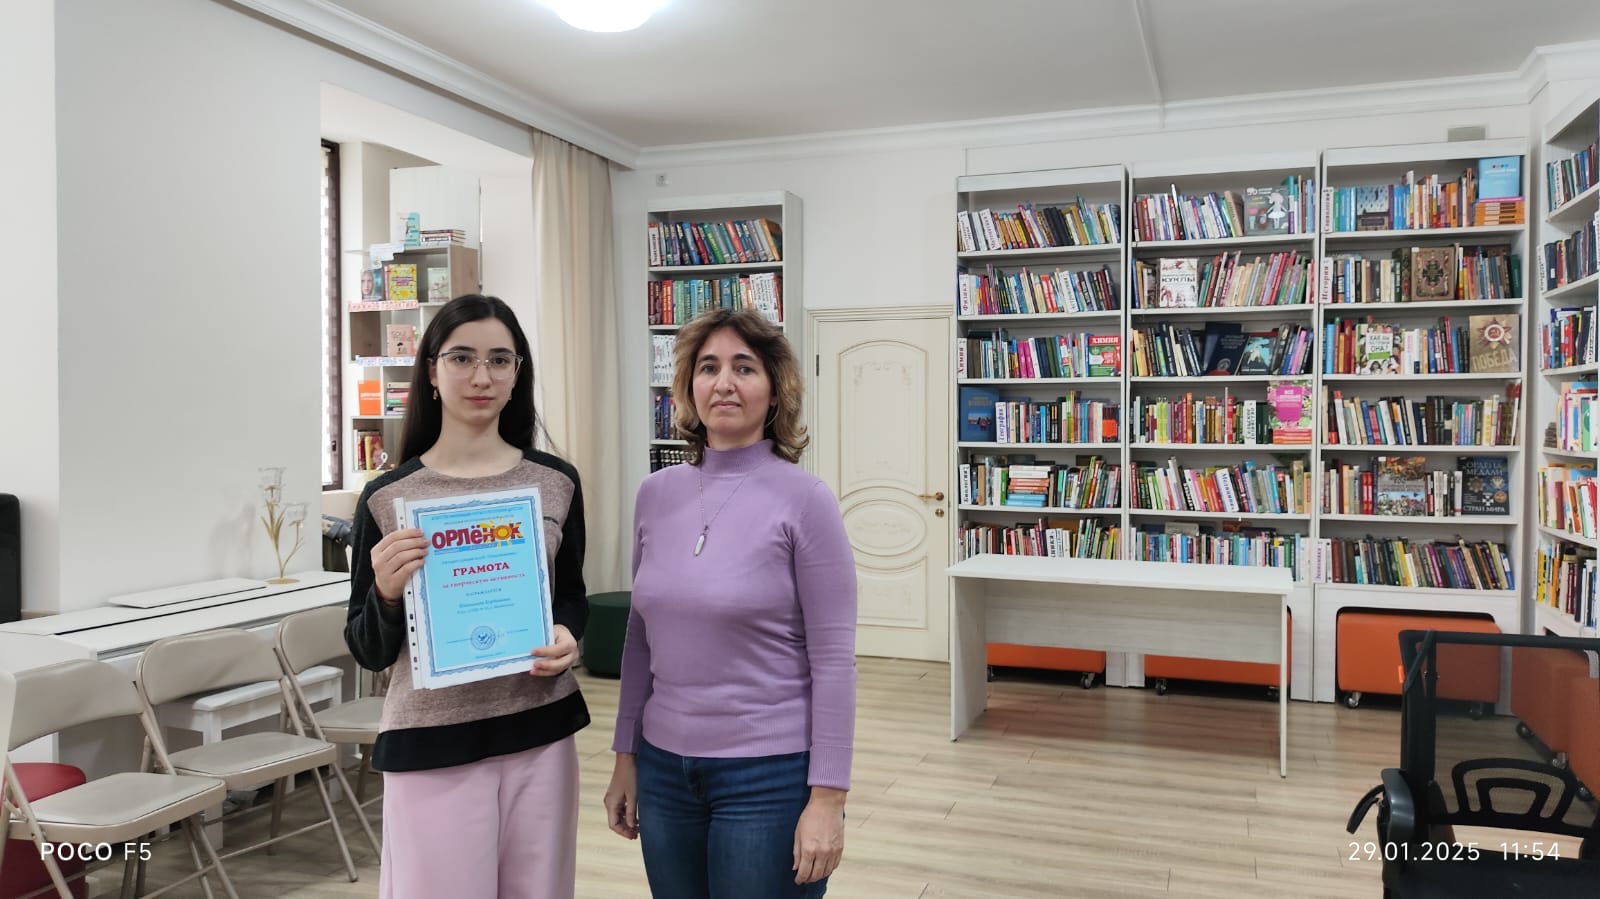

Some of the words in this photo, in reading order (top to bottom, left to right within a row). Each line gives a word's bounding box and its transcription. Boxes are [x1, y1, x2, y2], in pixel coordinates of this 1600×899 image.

[1321, 266, 1330, 300] История
[1092, 336, 1119, 345] ХИМИЯ
[957, 347, 965, 375] Химия
[1471, 347, 1518, 372] ПОБЕДА
[997, 408, 1006, 441] География
[453, 562, 510, 577] ГРАМОТА
